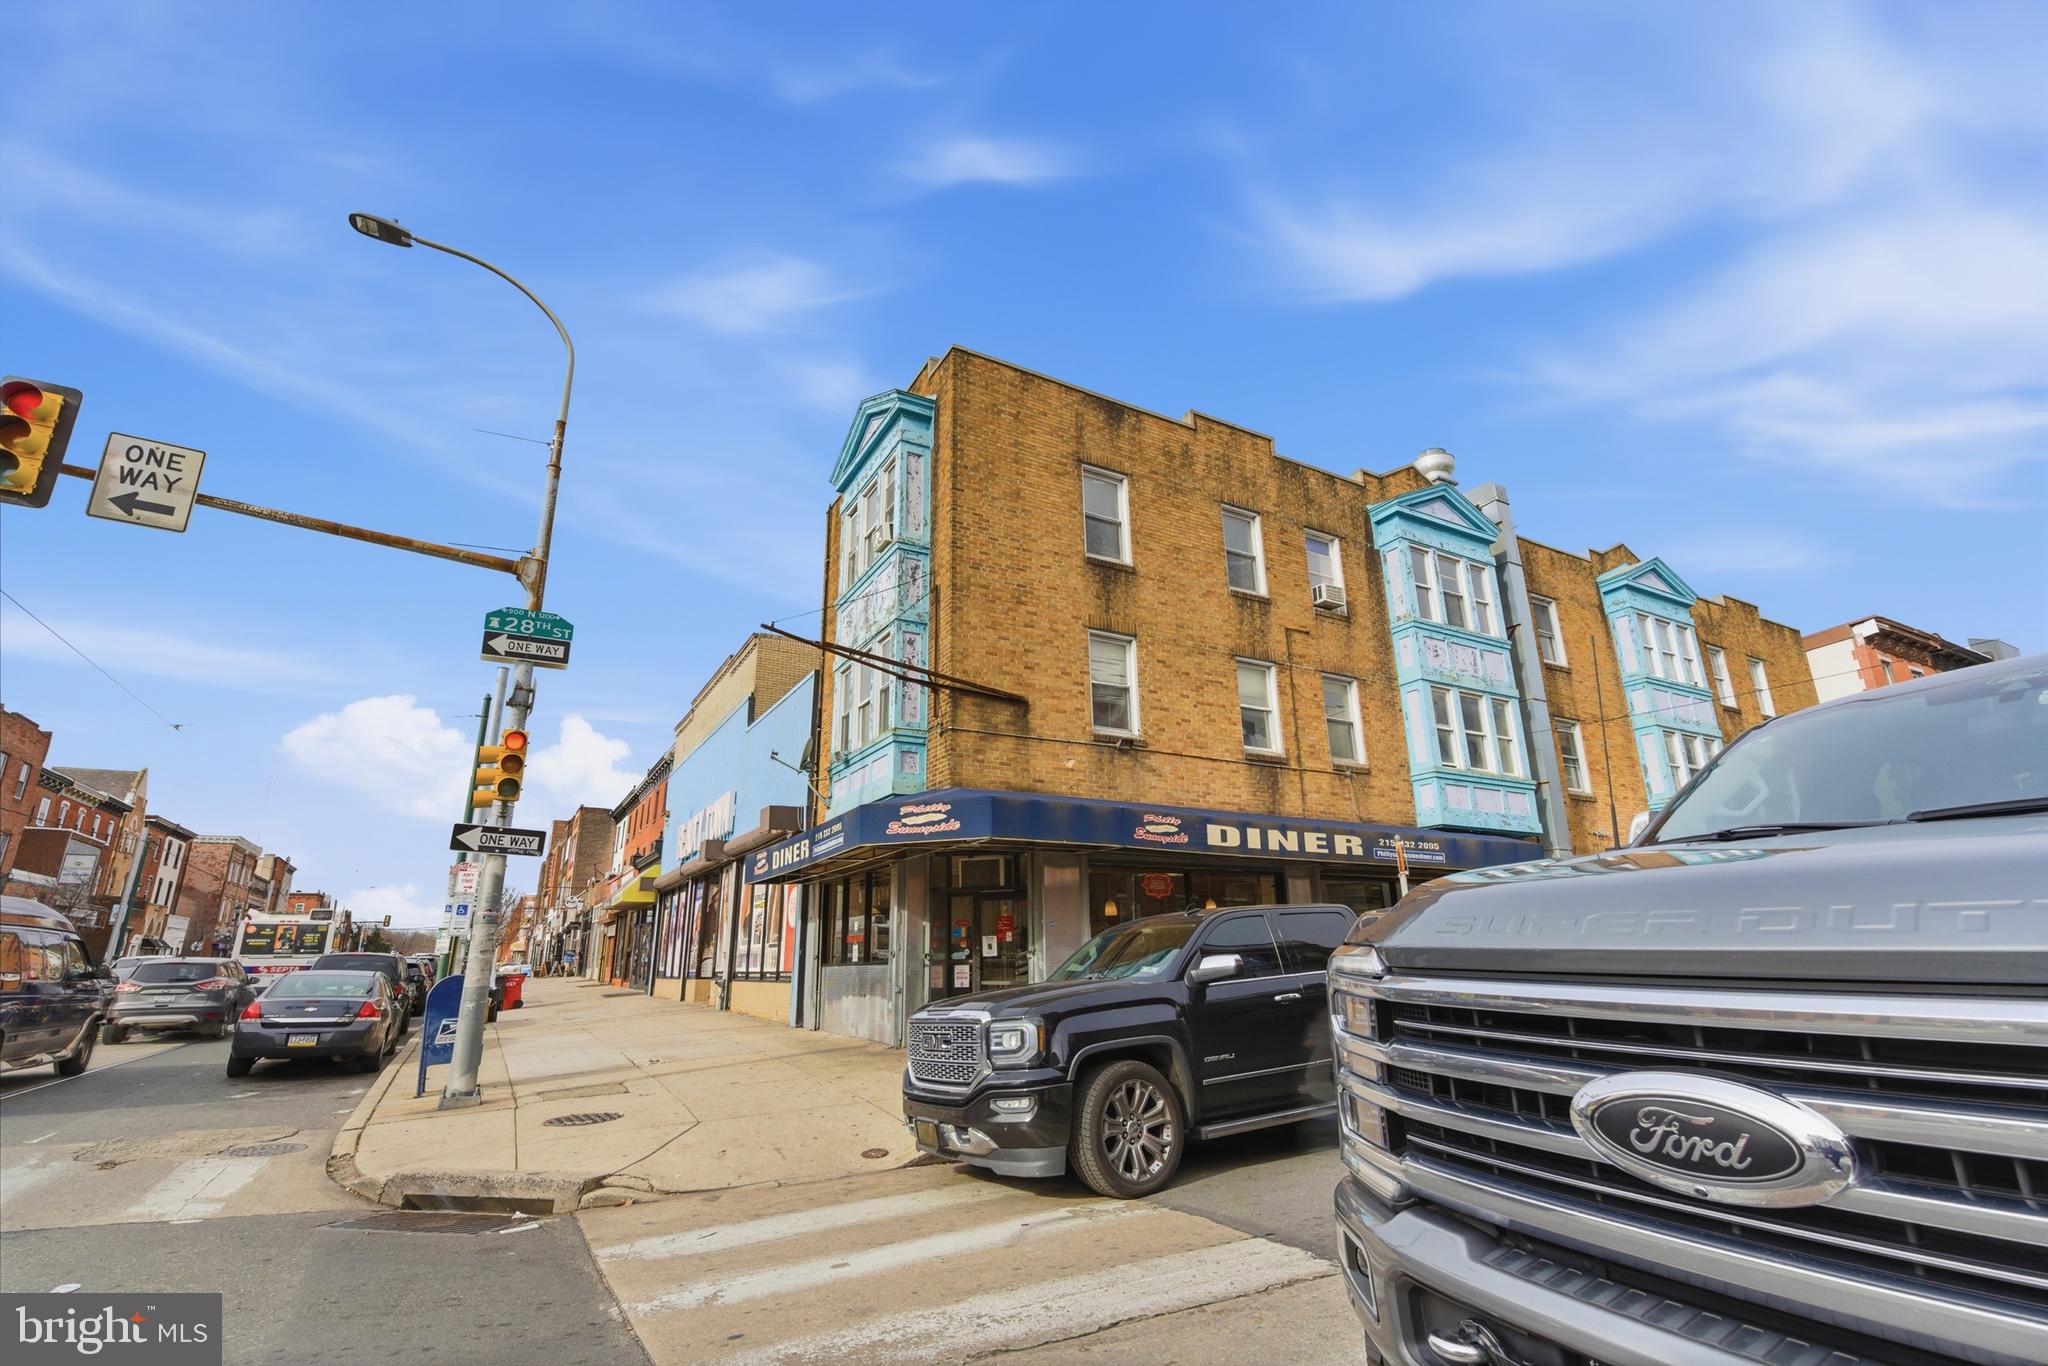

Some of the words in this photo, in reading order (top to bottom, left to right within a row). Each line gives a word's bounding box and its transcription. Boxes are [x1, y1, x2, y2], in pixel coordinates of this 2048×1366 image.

[125, 445, 186, 472] ONE
[120, 465, 183, 493] WAY
[504, 617, 551, 634] 28TH
[552, 627, 571, 639] ST
[508, 641, 532, 652] ONE
[536, 645, 560, 656] WAY
[899, 803, 952, 815] Philly
[886, 819, 961, 836] Sunnyside
[1134, 827, 1189, 844] Sunnyside
[480, 834, 505, 846] ONE
[510, 837, 535, 848] WAY
[1206, 824, 1364, 856] DINER
[1379, 839, 1396, 847] 215
[1417, 842, 1440, 850] 2095
[772, 839, 810, 870] DINER
[1434, 909, 1706, 935] SUPER
[270, 965, 300, 973] SEPTA
[922, 1034, 951, 1050] GMC
[1629, 1106, 1752, 1170] Ford
